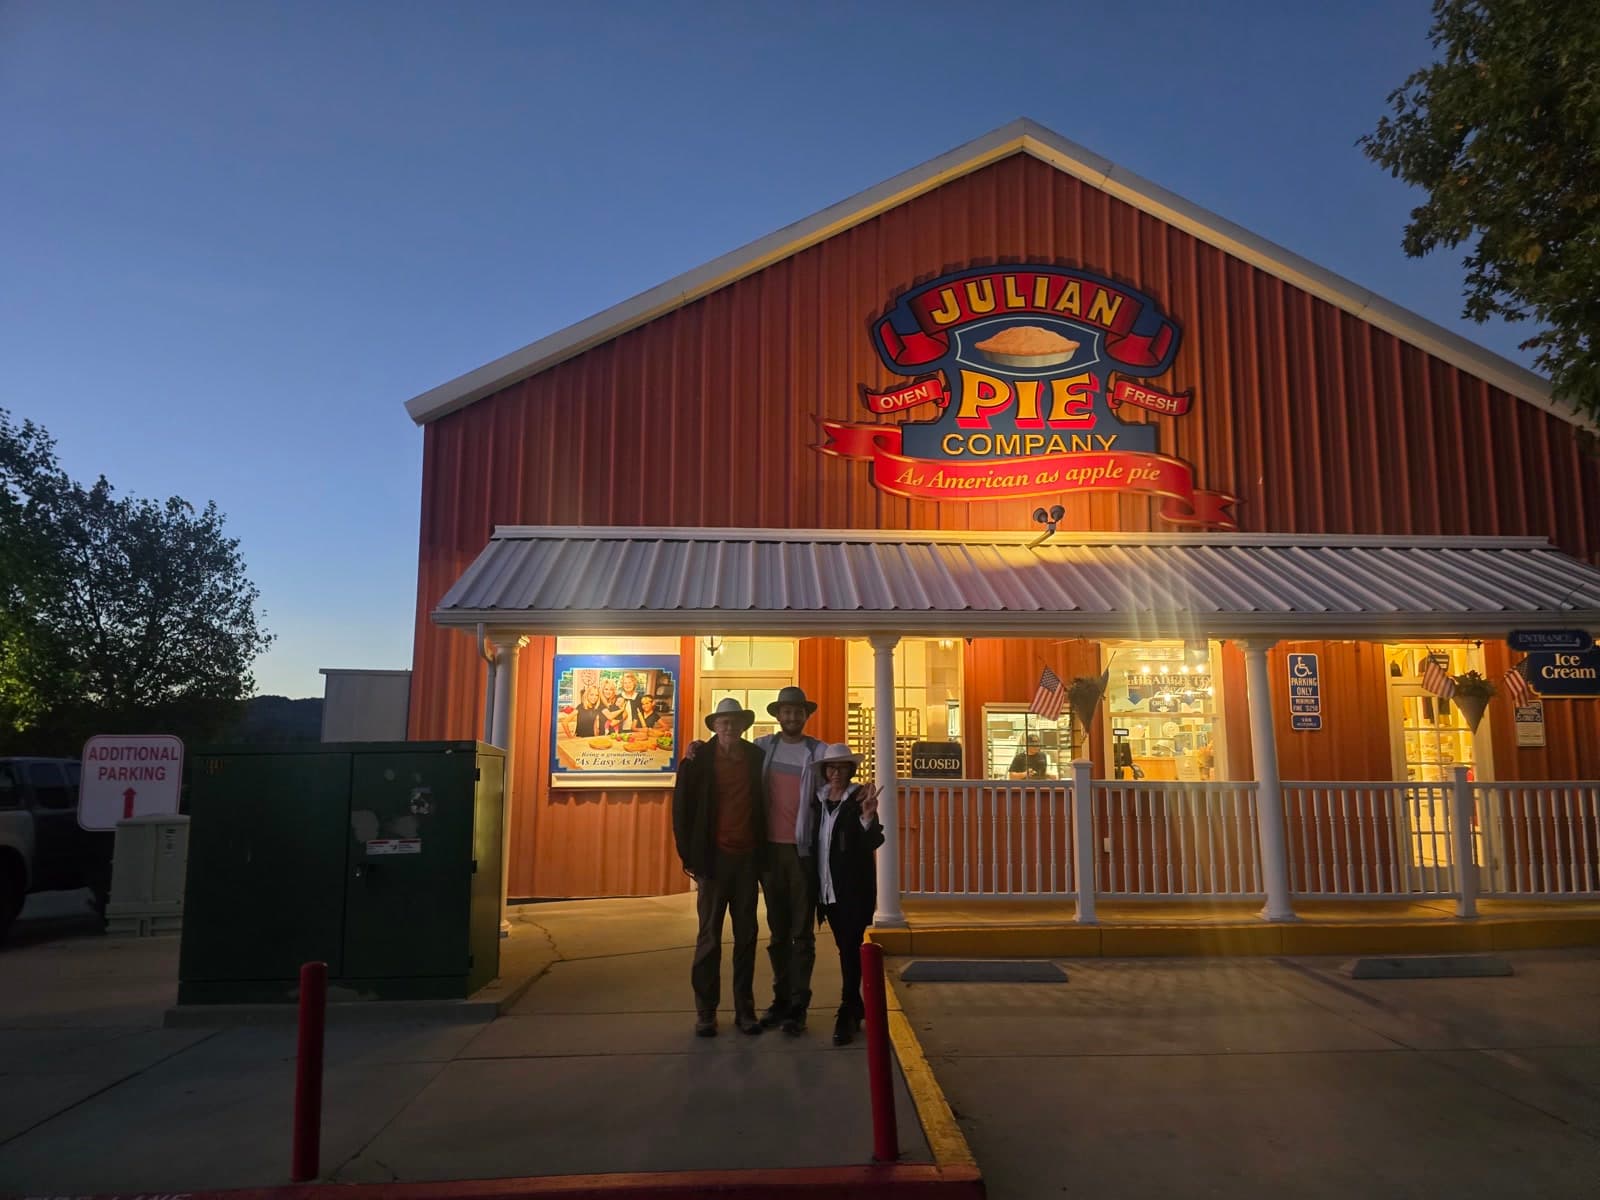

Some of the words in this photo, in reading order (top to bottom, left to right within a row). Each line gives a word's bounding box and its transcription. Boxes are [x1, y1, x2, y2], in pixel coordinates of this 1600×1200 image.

[931, 276, 1124, 327] JULIAN
[880, 386, 929, 409] OVEN
[956, 369, 1099, 428] PIE
[1124, 386, 1178, 413] FRESH
[941, 433, 1119, 457] COMPANY
[896, 469, 923, 485] As
[929, 469, 1029, 489] American
[1035, 470, 1060, 483] as
[1065, 460, 1123, 485] apple
[1127, 464, 1161, 485] pie
[1554, 653, 1581, 666] Ice
[1541, 665, 1597, 679] Cream
[1291, 677, 1318, 686] PARKING
[1296, 687, 1313, 696] ONLY
[89, 746, 178, 760] ADDITIONAL
[593, 758, 616, 767] Easy
[621, 758, 631, 766] As
[914, 758, 960, 770] CLOSED
[98, 767, 166, 780] PARKING
